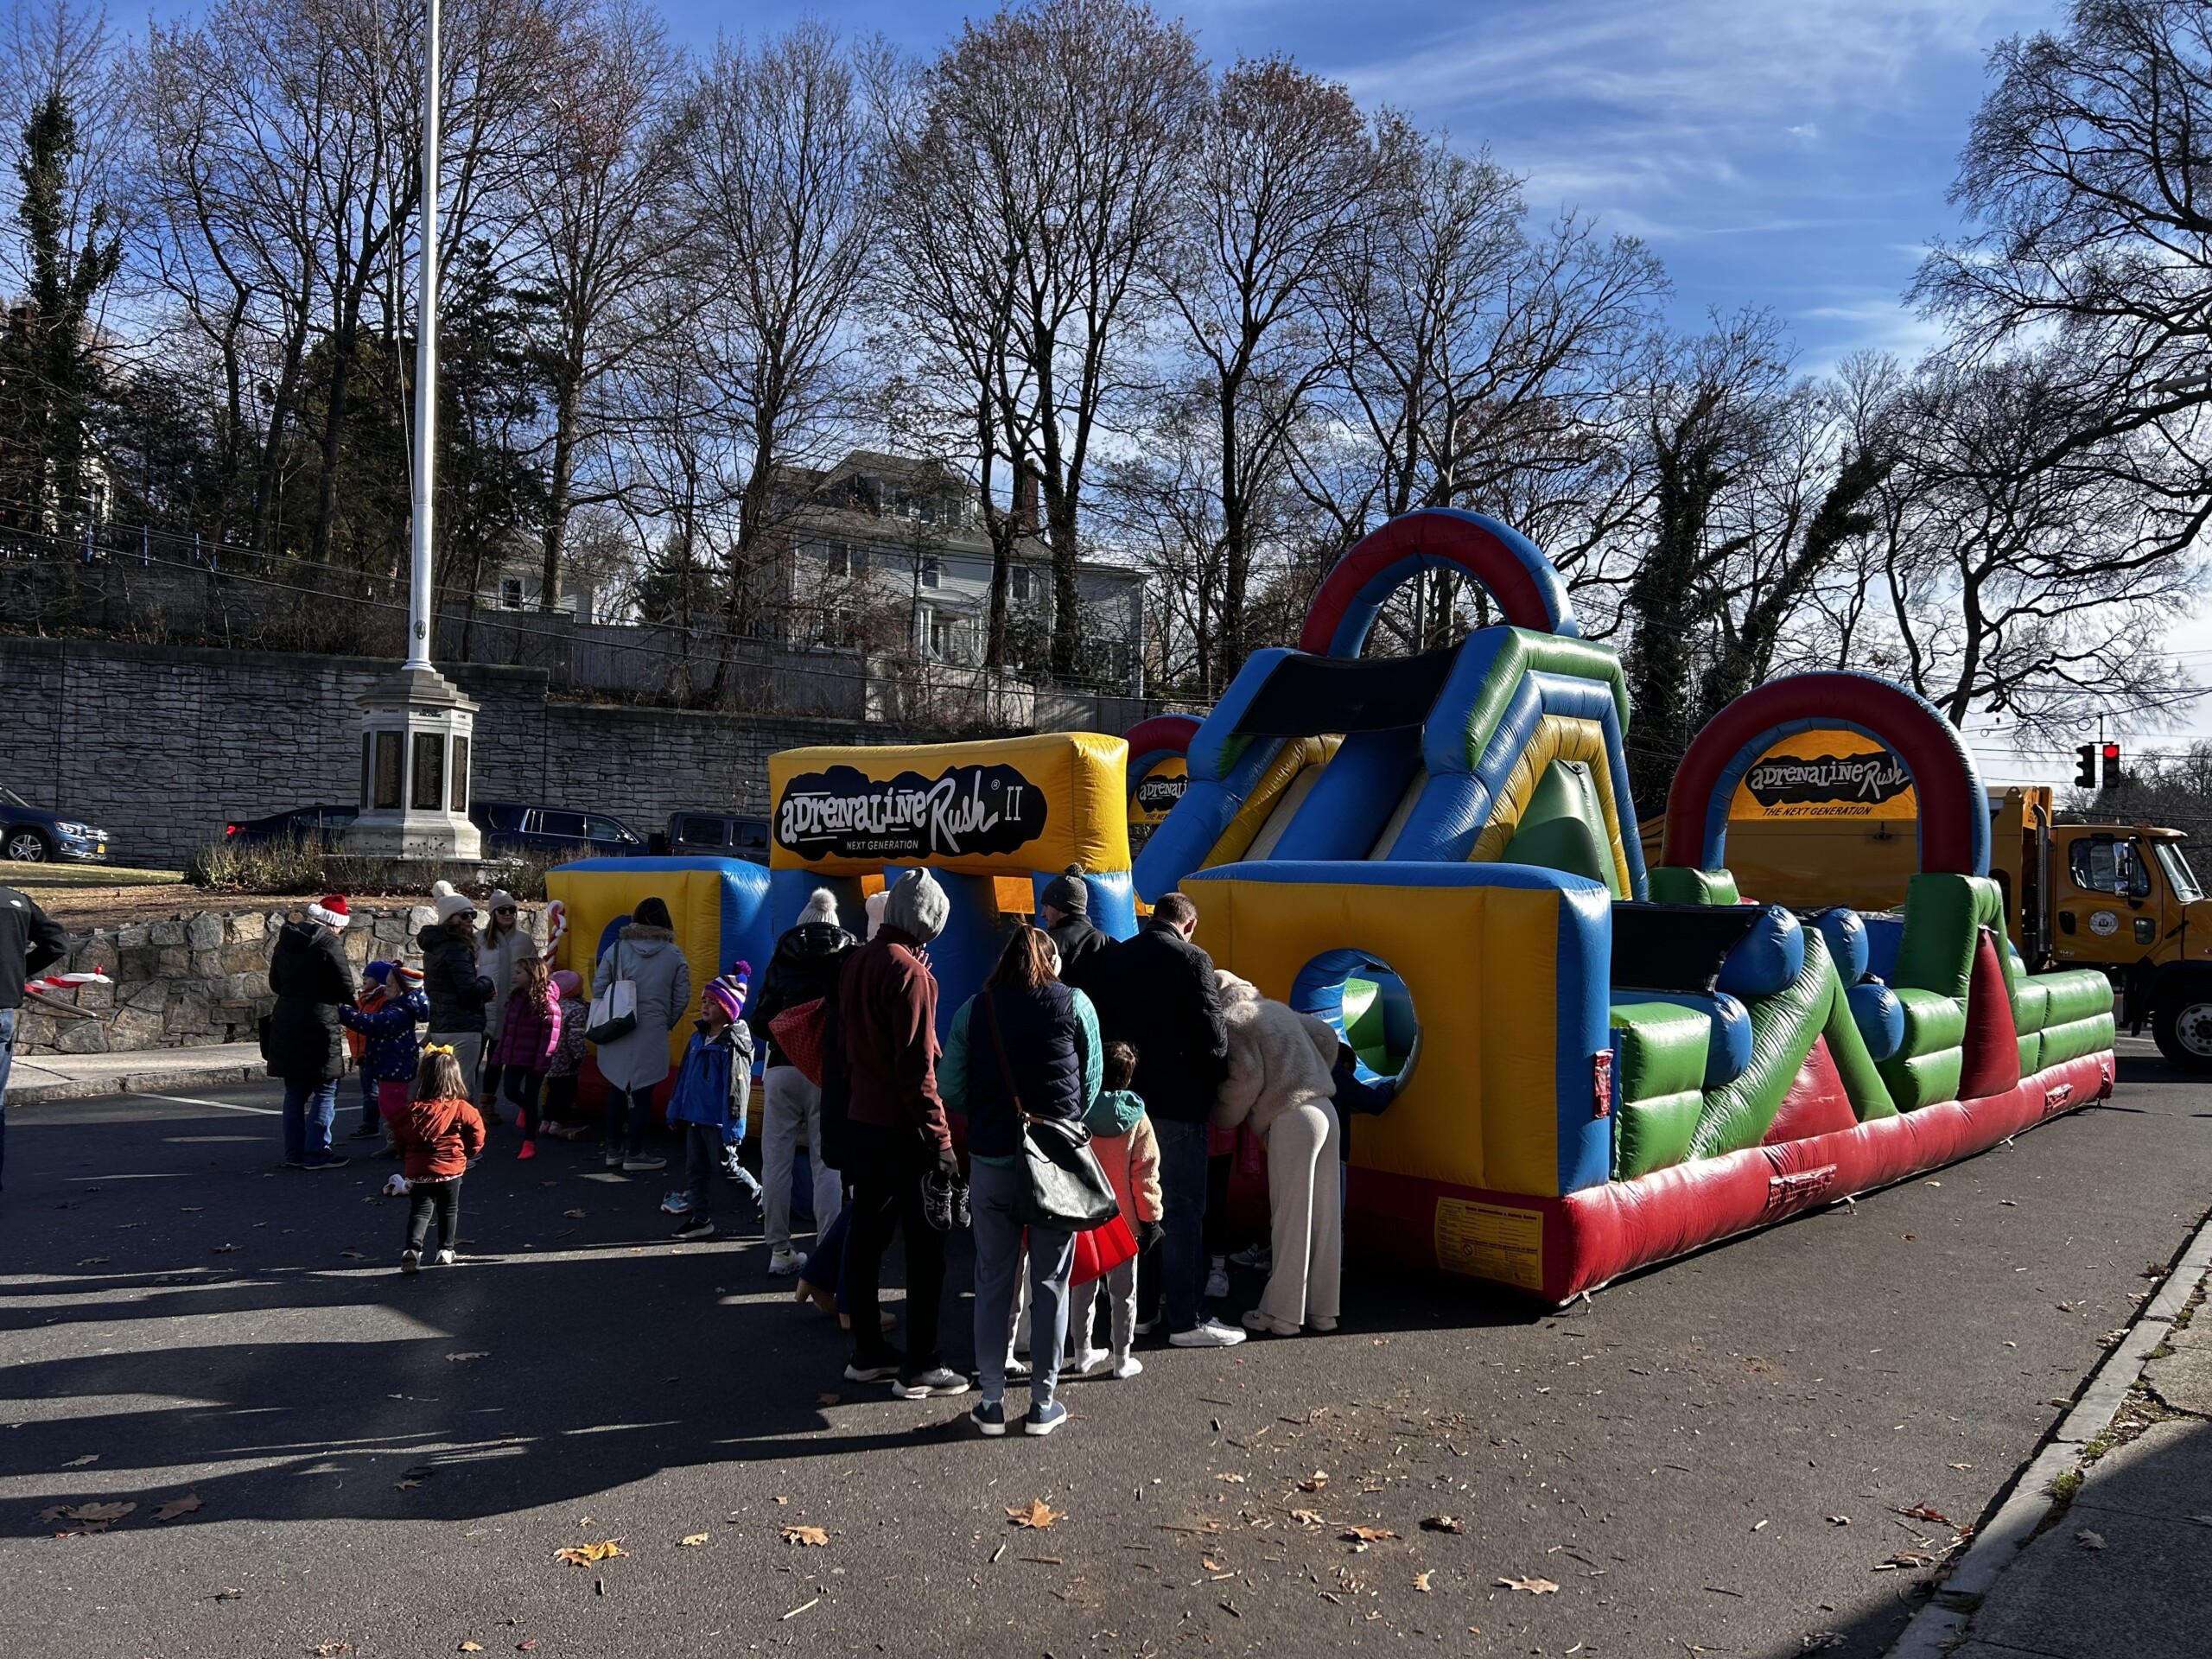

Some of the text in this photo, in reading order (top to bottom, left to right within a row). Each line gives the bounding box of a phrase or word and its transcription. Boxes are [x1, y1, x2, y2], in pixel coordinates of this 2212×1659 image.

[1858, 756, 1910, 799] Rush
[926, 770, 999, 853] Rush
[1005, 785, 1023, 821] II
[1763, 806, 1873, 817] THE NEXT GENERATION
[847, 840, 919, 850] NEXT GENERATION
